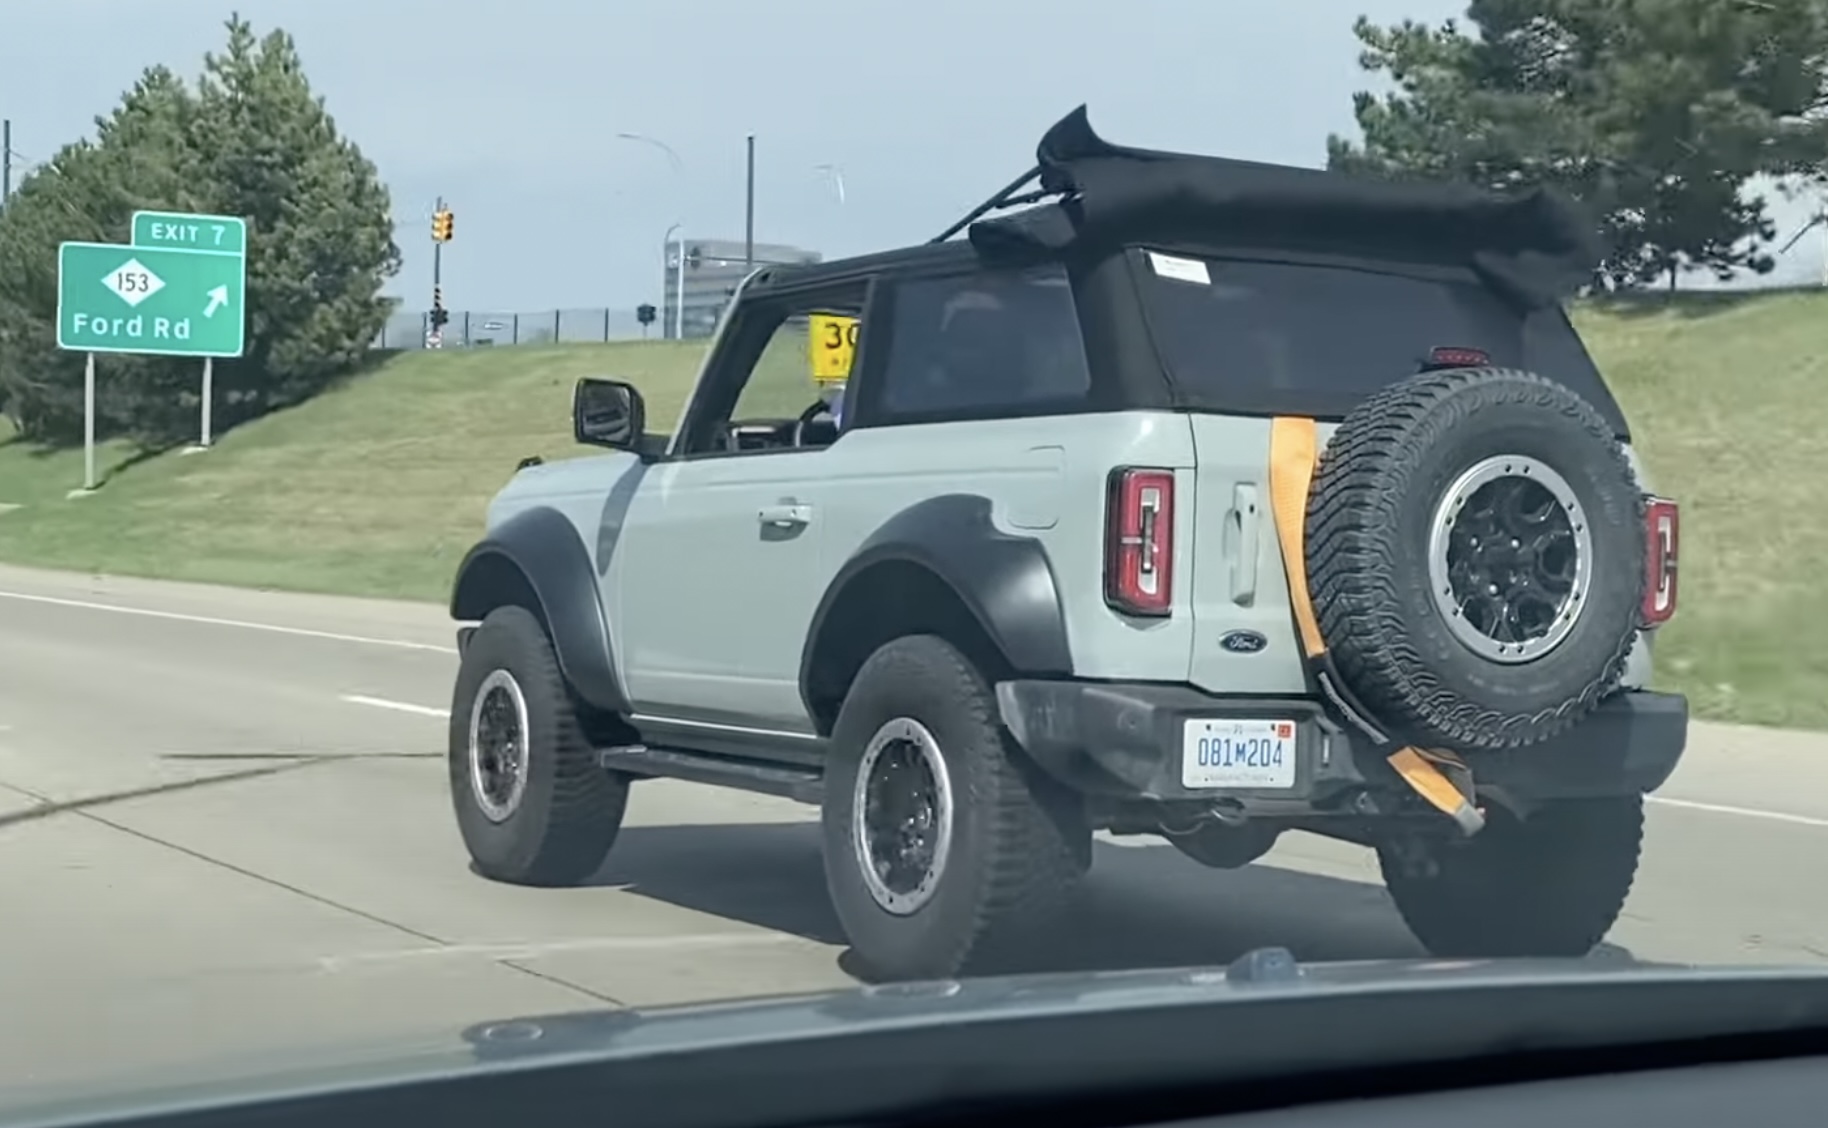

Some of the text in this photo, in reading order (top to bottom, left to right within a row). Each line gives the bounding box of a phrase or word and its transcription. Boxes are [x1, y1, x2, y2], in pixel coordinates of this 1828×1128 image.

[151, 222, 226, 246] EXIT 7
[117, 272, 150, 293] 153
[73, 313, 191, 340] Ford Rd
[1198, 738, 1283, 768] 081M204
